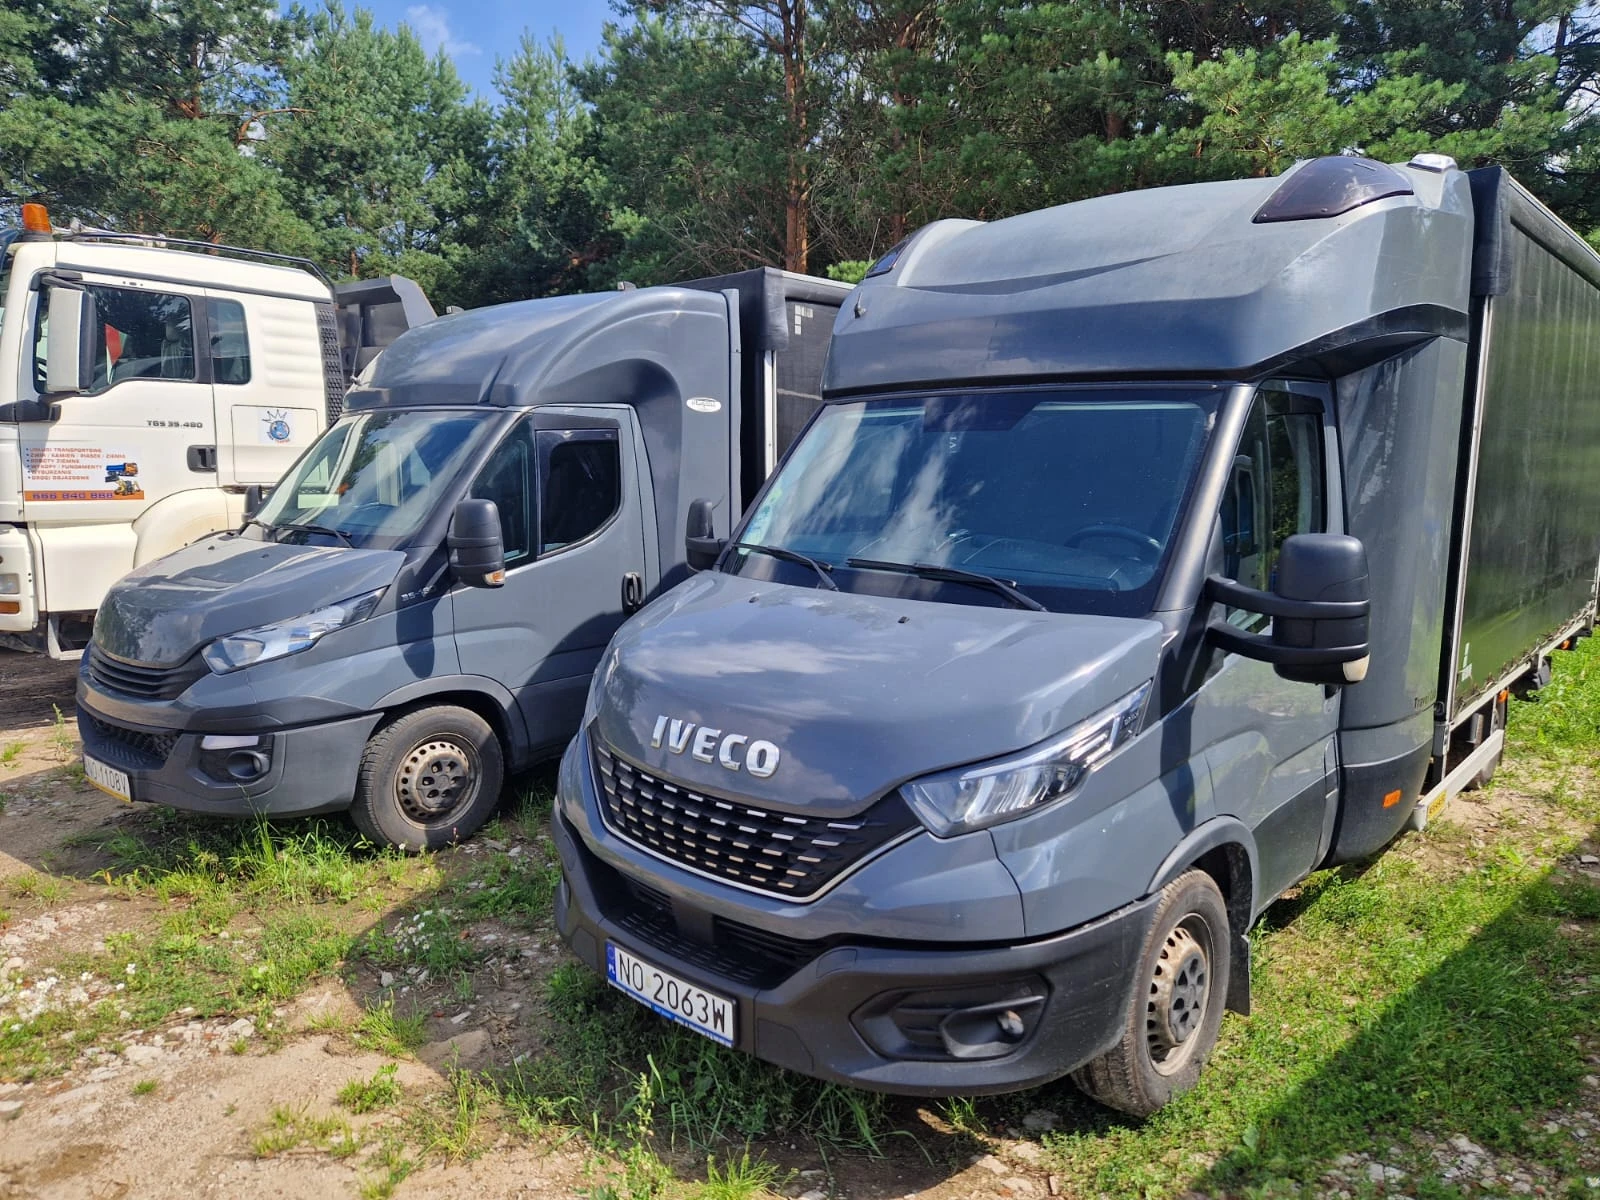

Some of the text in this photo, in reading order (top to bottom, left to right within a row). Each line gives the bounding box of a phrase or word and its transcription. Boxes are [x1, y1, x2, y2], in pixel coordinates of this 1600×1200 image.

[650, 715, 780, 777] IVECO
[619, 953, 644, 992] NO
[652, 972, 726, 1033] 2063W
